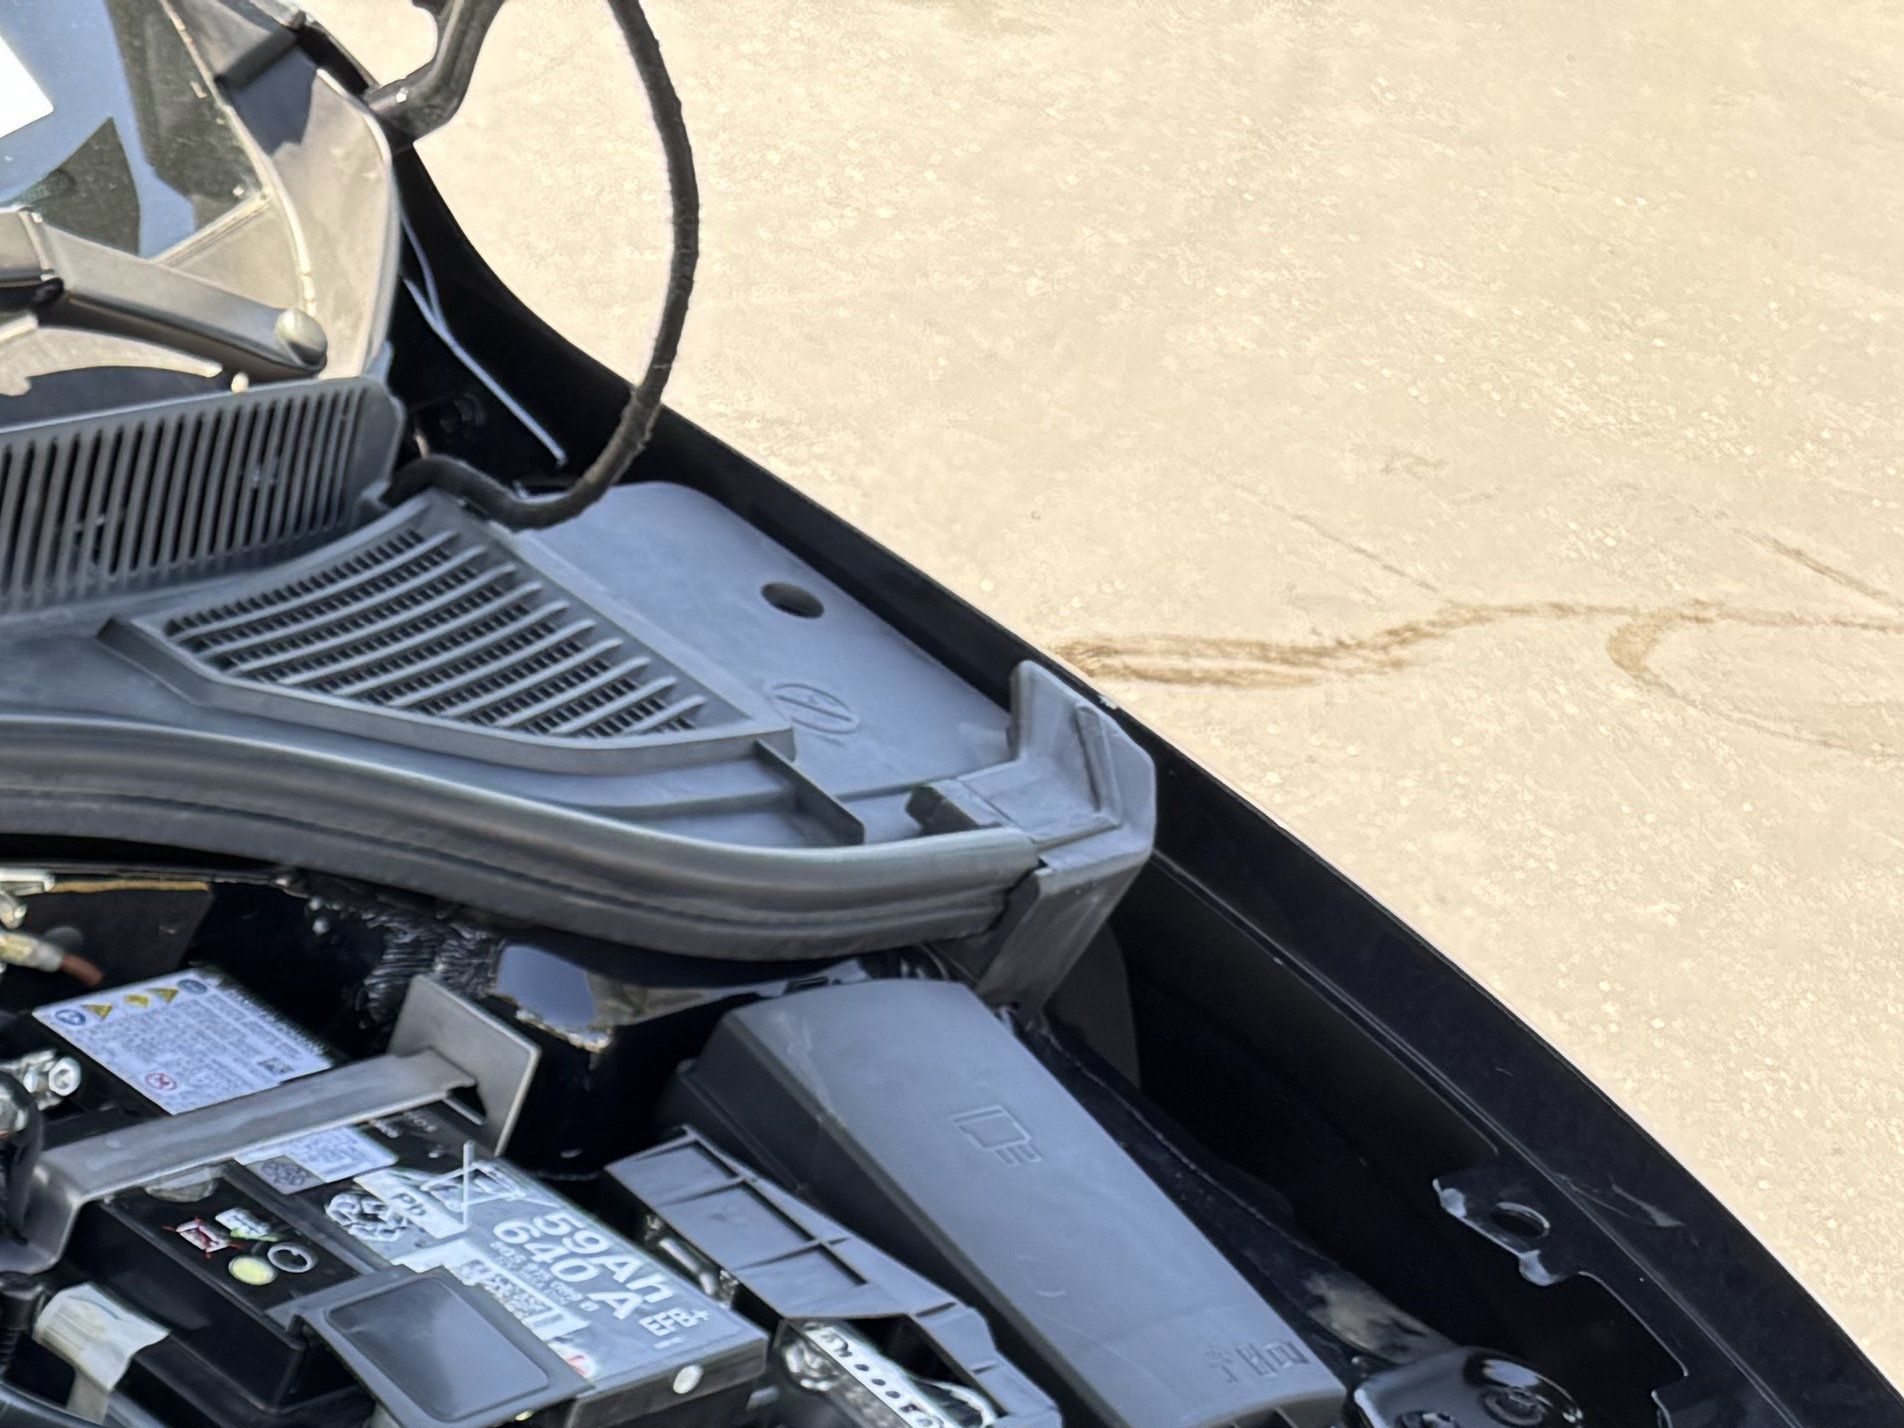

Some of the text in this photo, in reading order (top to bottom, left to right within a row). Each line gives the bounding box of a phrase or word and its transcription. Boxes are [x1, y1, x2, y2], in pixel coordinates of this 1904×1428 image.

[388, 1191, 434, 1217] Pb
[493, 1219, 598, 1284] 640
[587, 1291, 646, 1319] A
[533, 1210, 682, 1302] 59Ah
